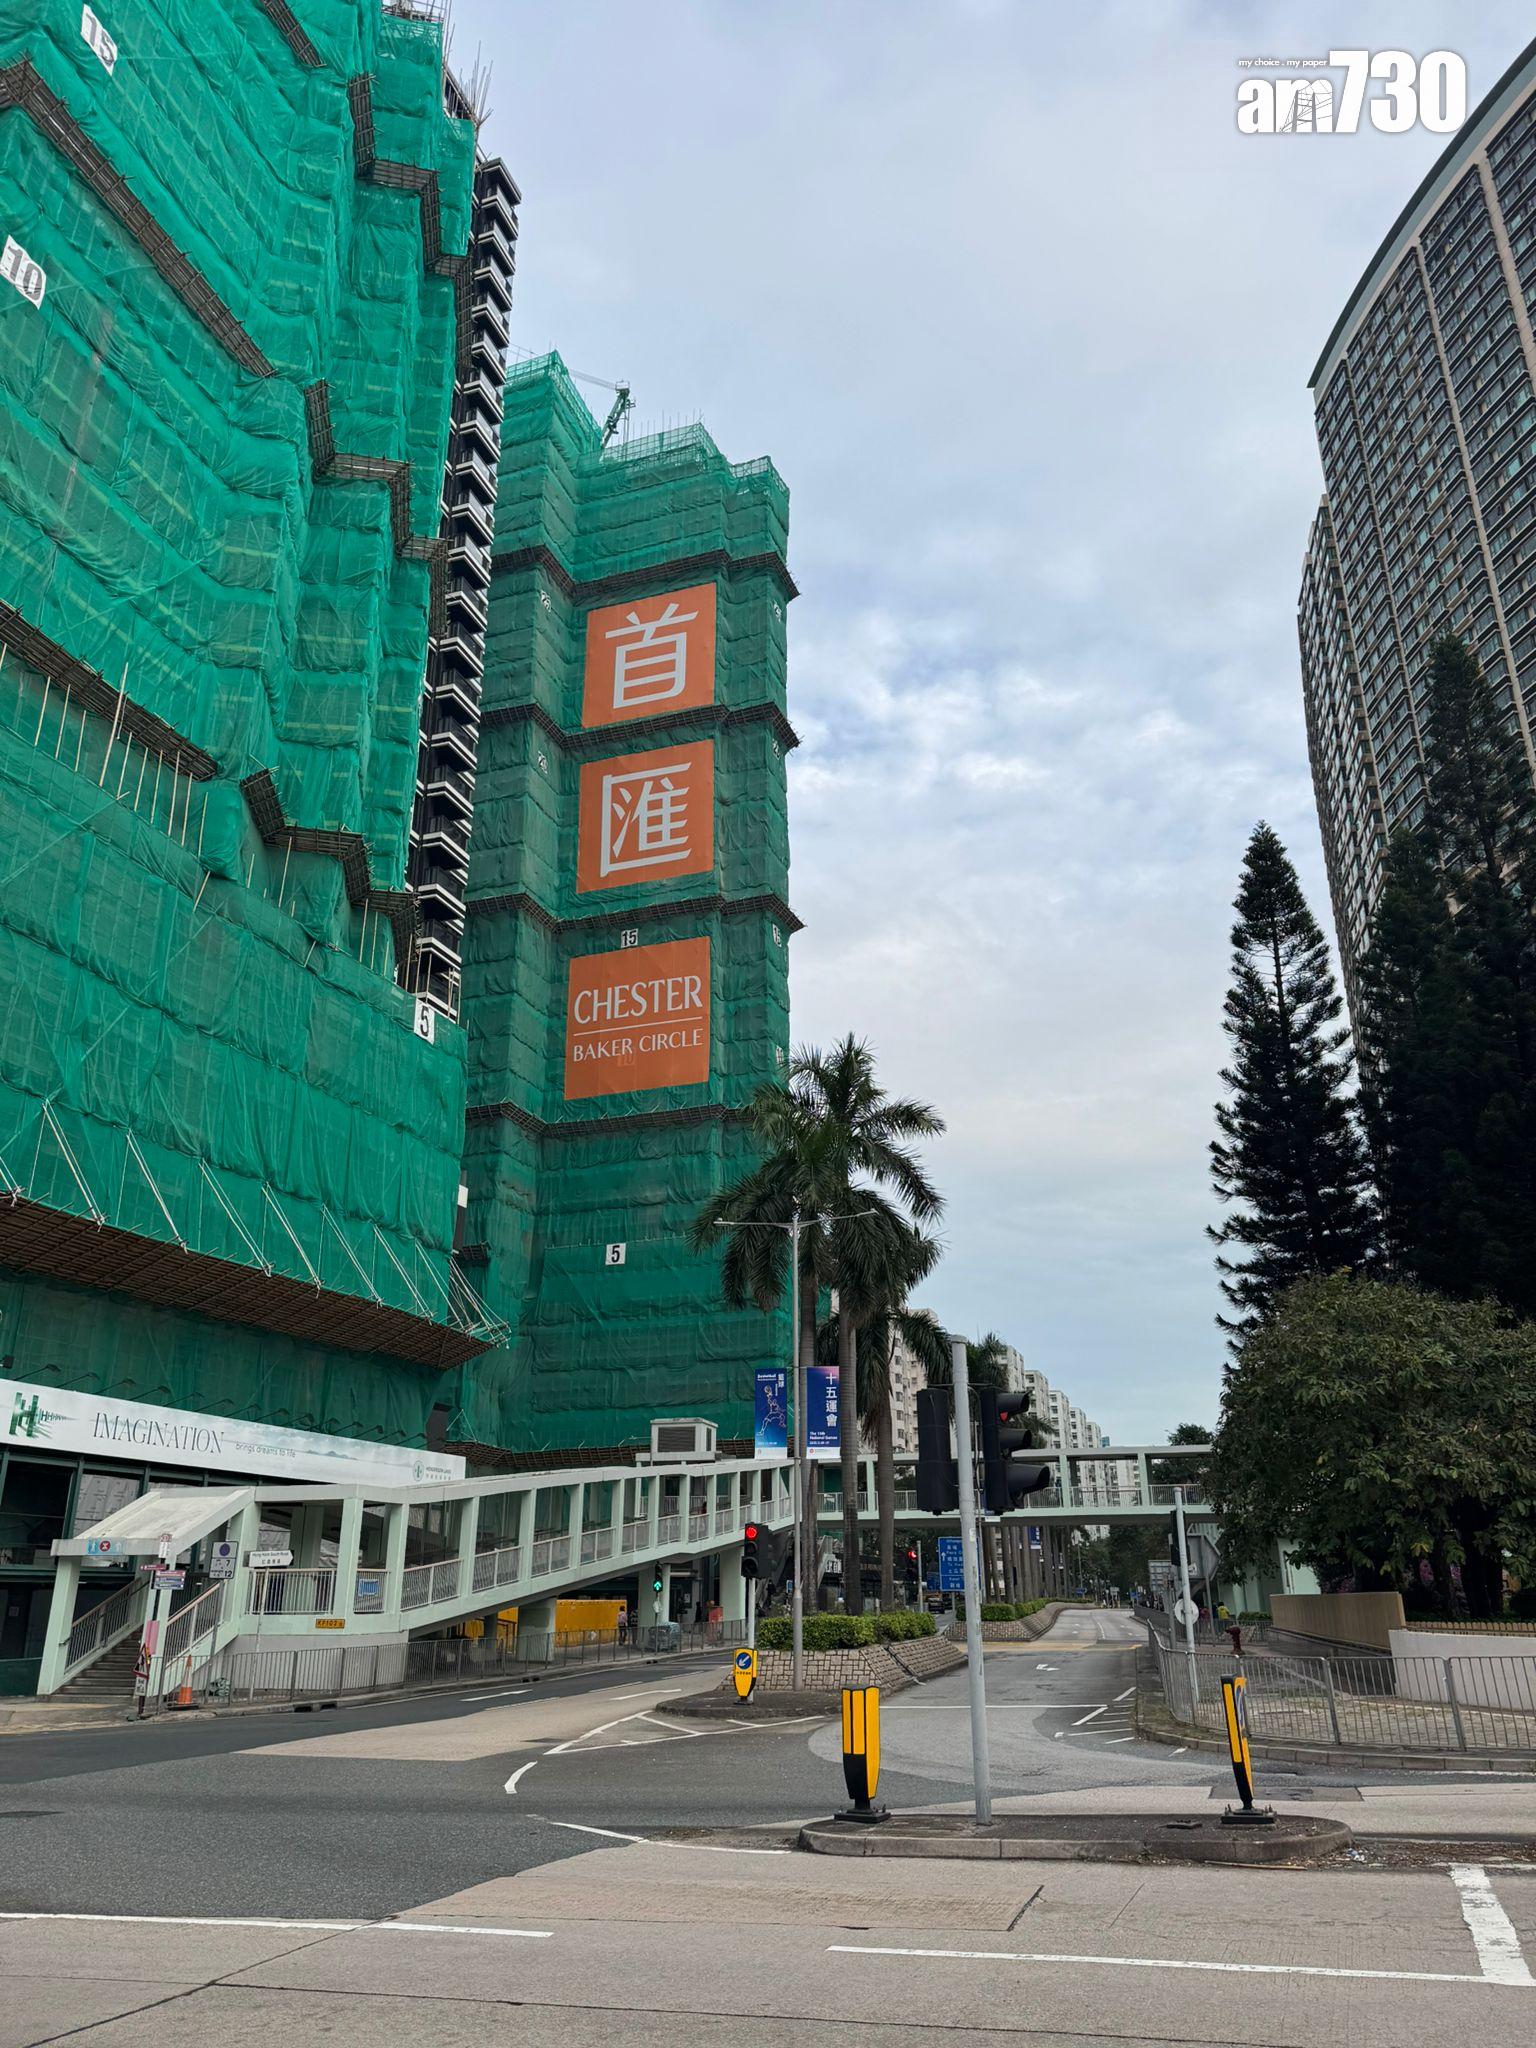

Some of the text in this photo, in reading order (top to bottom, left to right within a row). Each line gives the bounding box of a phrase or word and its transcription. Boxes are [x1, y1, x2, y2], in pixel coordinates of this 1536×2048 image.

[86, 13, 115, 67] 15
[8, 246, 42, 301] 10
[604, 602, 699, 709] 首
[622, 930, 637, 946] 15
[420, 1005, 429, 1037] 5
[574, 975, 703, 1025] CHESTER
[573, 1028, 703, 1062] BAKER CIRCLE
[611, 1244, 620, 1263] 5
[826, 1373, 838, 1427] 十五運會
[93, 1412, 225, 1454] IMAGINATION
[224, 1570, 233, 1578] 12
